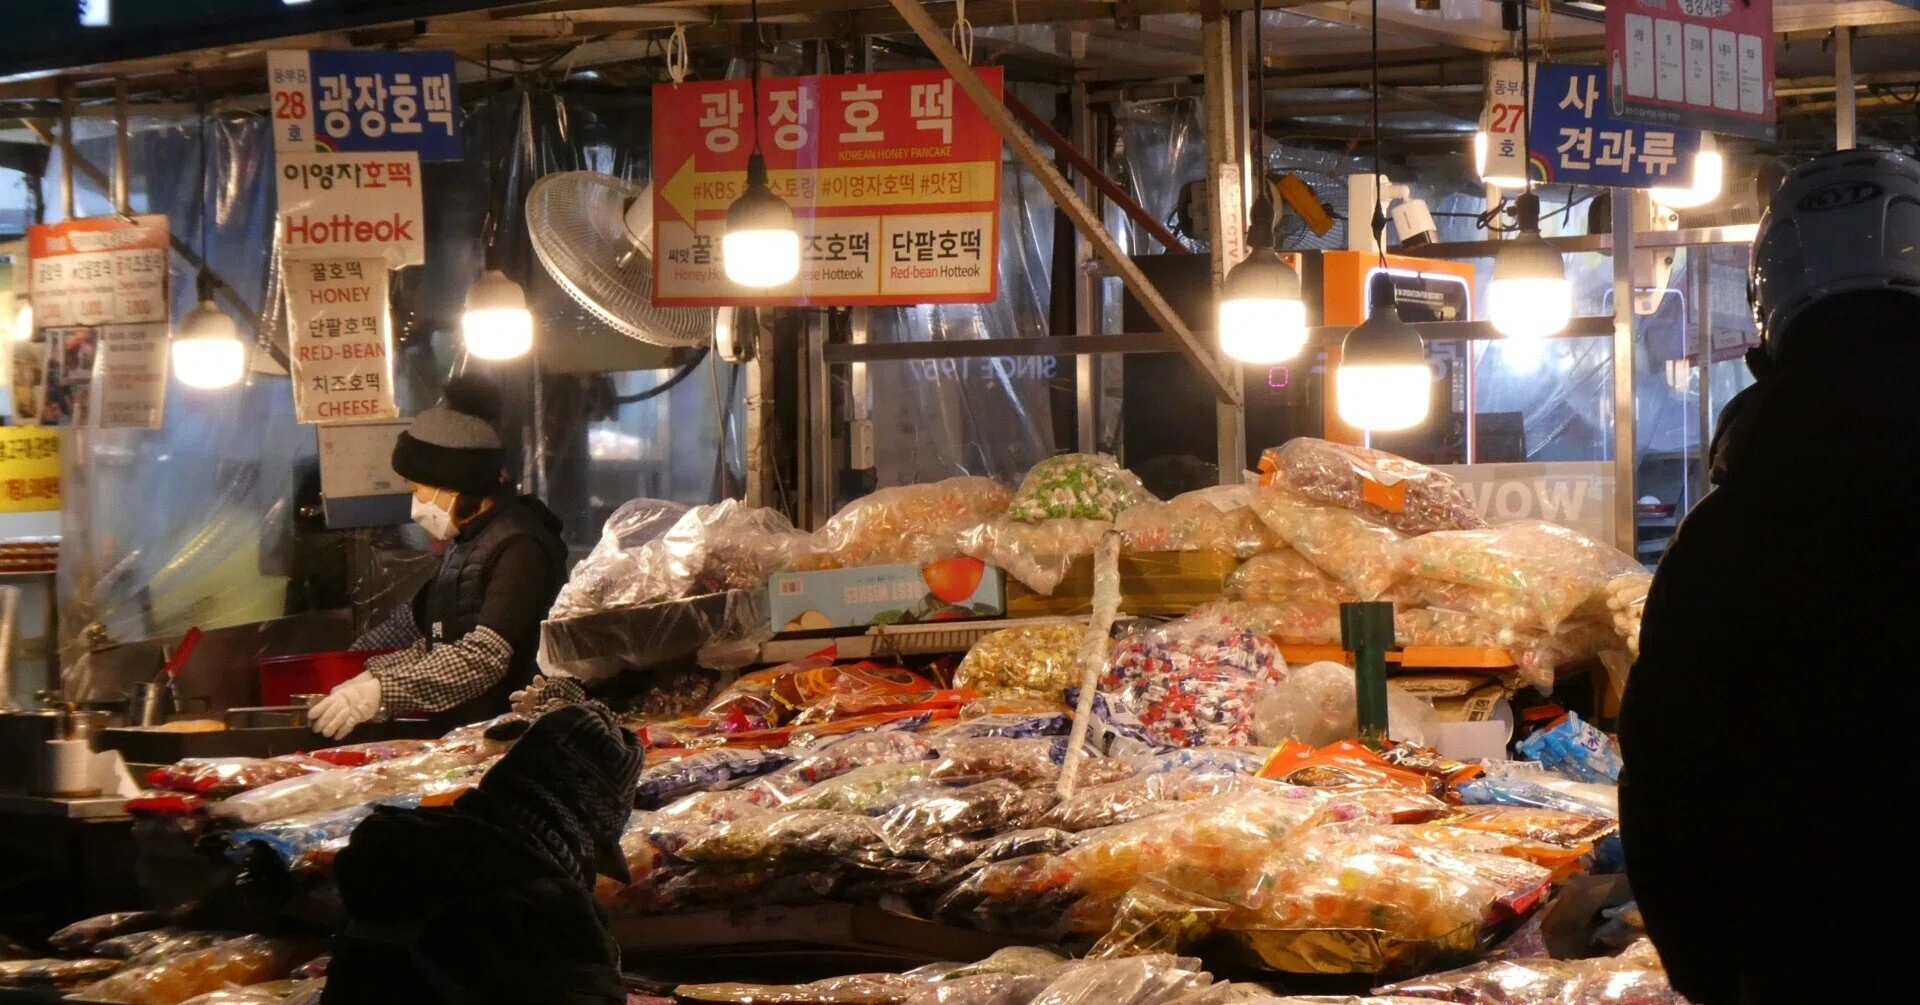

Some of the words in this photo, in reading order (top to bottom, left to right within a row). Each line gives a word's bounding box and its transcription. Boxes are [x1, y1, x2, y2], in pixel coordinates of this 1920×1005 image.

[1494, 79, 1525, 96] 동부
[1558, 74, 1600, 119] 사
[274, 90, 307, 120] 28
[318, 73, 454, 139] 광장호떡
[1490, 103, 1525, 134] 27
[288, 124, 303, 142] 호
[838, 150, 875, 161] KOREAN
[879, 148, 908, 160] HONEY
[910, 145, 953, 158] PANCAKE
[1498, 139, 1515, 158] 호
[1556, 127, 1678, 176] 견과류
[283, 161, 412, 190] 이영자호떡
[692, 180, 737, 201] #KBS
[822, 172, 916, 198] #이영자호떡
[919, 170, 964, 195] #맛집
[285, 212, 414, 245] Hotteok
[802, 232, 869, 263] 즈호떡
[891, 228, 982, 262] 단팥호떡
[310, 261, 363, 282] 꿀호떡
[822, 267, 864, 281] Hotteok
[890, 266, 938, 280] Red-bean
[940, 264, 981, 278] Hotteok
[310, 287, 370, 305] HONEY
[309, 315, 378, 338] 단팥호떡
[300, 343, 386, 362] RED-BEAN
[312, 372, 381, 395] 치즈호떡
[317, 399, 379, 418] CHEESE
